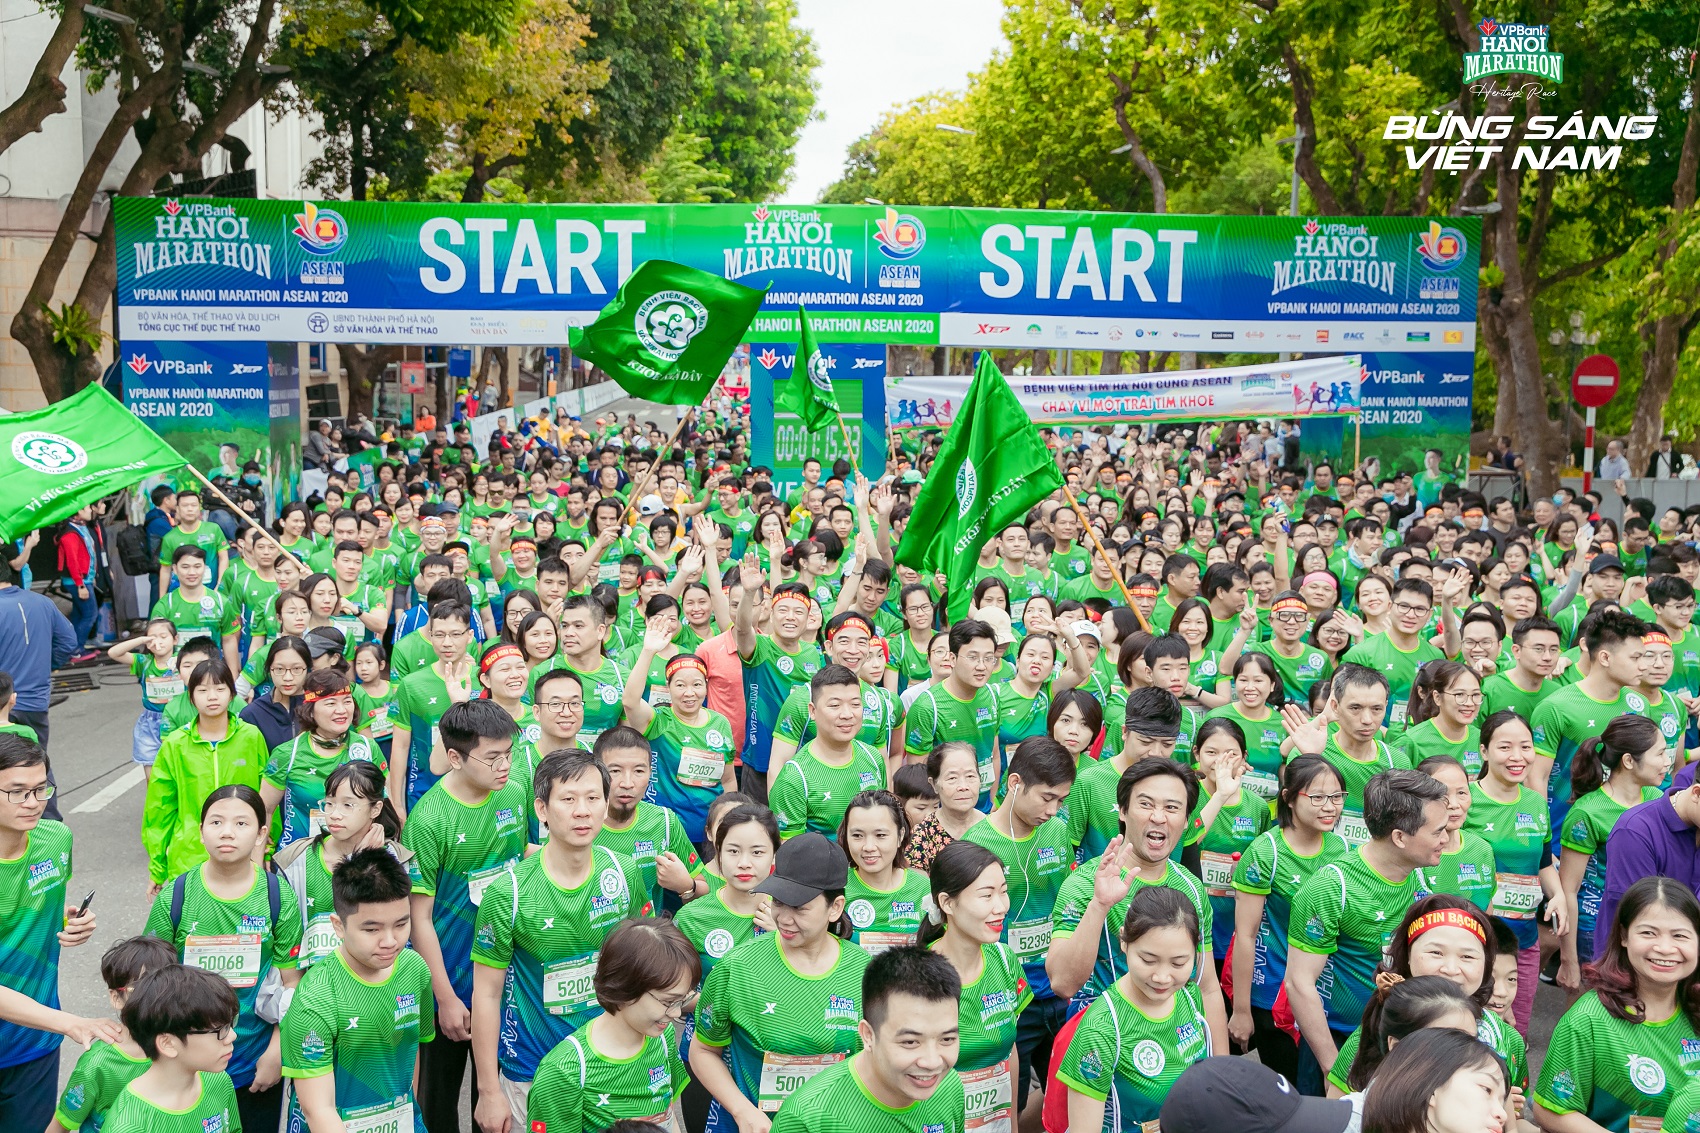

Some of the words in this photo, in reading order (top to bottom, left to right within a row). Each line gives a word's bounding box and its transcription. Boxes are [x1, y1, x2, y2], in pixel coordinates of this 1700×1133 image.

[185, 204, 236, 217] VPBank
[772, 210, 821, 222] VPBank
[155, 216, 249, 239] HANOI
[744, 222, 833, 244] HANOI
[1323, 224, 1368, 235] VPBank
[1295, 236, 1378, 257] HANOI
[134, 242, 271, 280] MARATHON
[419, 217, 646, 294] START
[302, 261, 344, 275] ASEAN
[723, 247, 852, 284] MARATHON
[979, 224, 1198, 303] START
[880, 265, 920, 279] ASEAN
[1272, 260, 1396, 296] MARATHON
[1421, 278, 1459, 290] ASEAN
[133, 289, 178, 301] VPBANK
[181, 289, 215, 301] HANOI
[219, 290, 281, 302] MARATHON
[283, 291, 319, 303] ASEAN
[322, 291, 349, 303] 2020
[765, 292, 799, 304] HANOI
[801, 293, 858, 305] MARATHON
[861, 294, 895, 306] ASEAN
[898, 294, 923, 306] 2020
[1267, 302, 1307, 314] VPBANK
[1310, 303, 1341, 314] HANOI
[1344, 303, 1398, 314] MARATHON
[1401, 303, 1432, 315] ASEAN
[1436, 304, 1460, 315] 2020
[210, 313, 233, 321] THAO
[248, 313, 260, 321] DU
[333, 315, 355, 323] UBND
[164, 323, 180, 333] CỤC
[201, 324, 218, 333] DỤC
[238, 324, 260, 332] THAO
[416, 327, 438, 335] THAO
[756, 319, 792, 332] HANOI
[864, 320, 902, 333] ASEAN
[905, 320, 934, 333] 2020
[153, 361, 213, 374] VPBank
[1088, 383, 1109, 392] TIM
[1192, 376, 1232, 387] ASEAN
[1372, 371, 1425, 384] VPBank
[129, 388, 170, 398] VPBANK
[173, 388, 204, 399] HANOI
[207, 388, 263, 399] MARATHON
[1155, 396, 1176, 410] TIM
[1360, 397, 1385, 407] BANK
[1388, 397, 1415, 407] HANOI
[1418, 397, 1468, 407] MARATHON
[130, 403, 176, 417] ASEAN
[180, 403, 213, 416] 2020
[1348, 410, 1391, 423] ASEAN
[1393, 410, 1422, 424] 2020
[688, 763, 715, 777] 52037
[1344, 824, 1372, 840] 5188
[1426, 912, 1445, 925] TIN
[1448, 912, 1477, 929] BẠCH
[1019, 931, 1051, 950] 52398
[198, 955, 244, 970] 50068
[776, 1076, 806, 1091] 500
[966, 1088, 997, 1111] 0972
